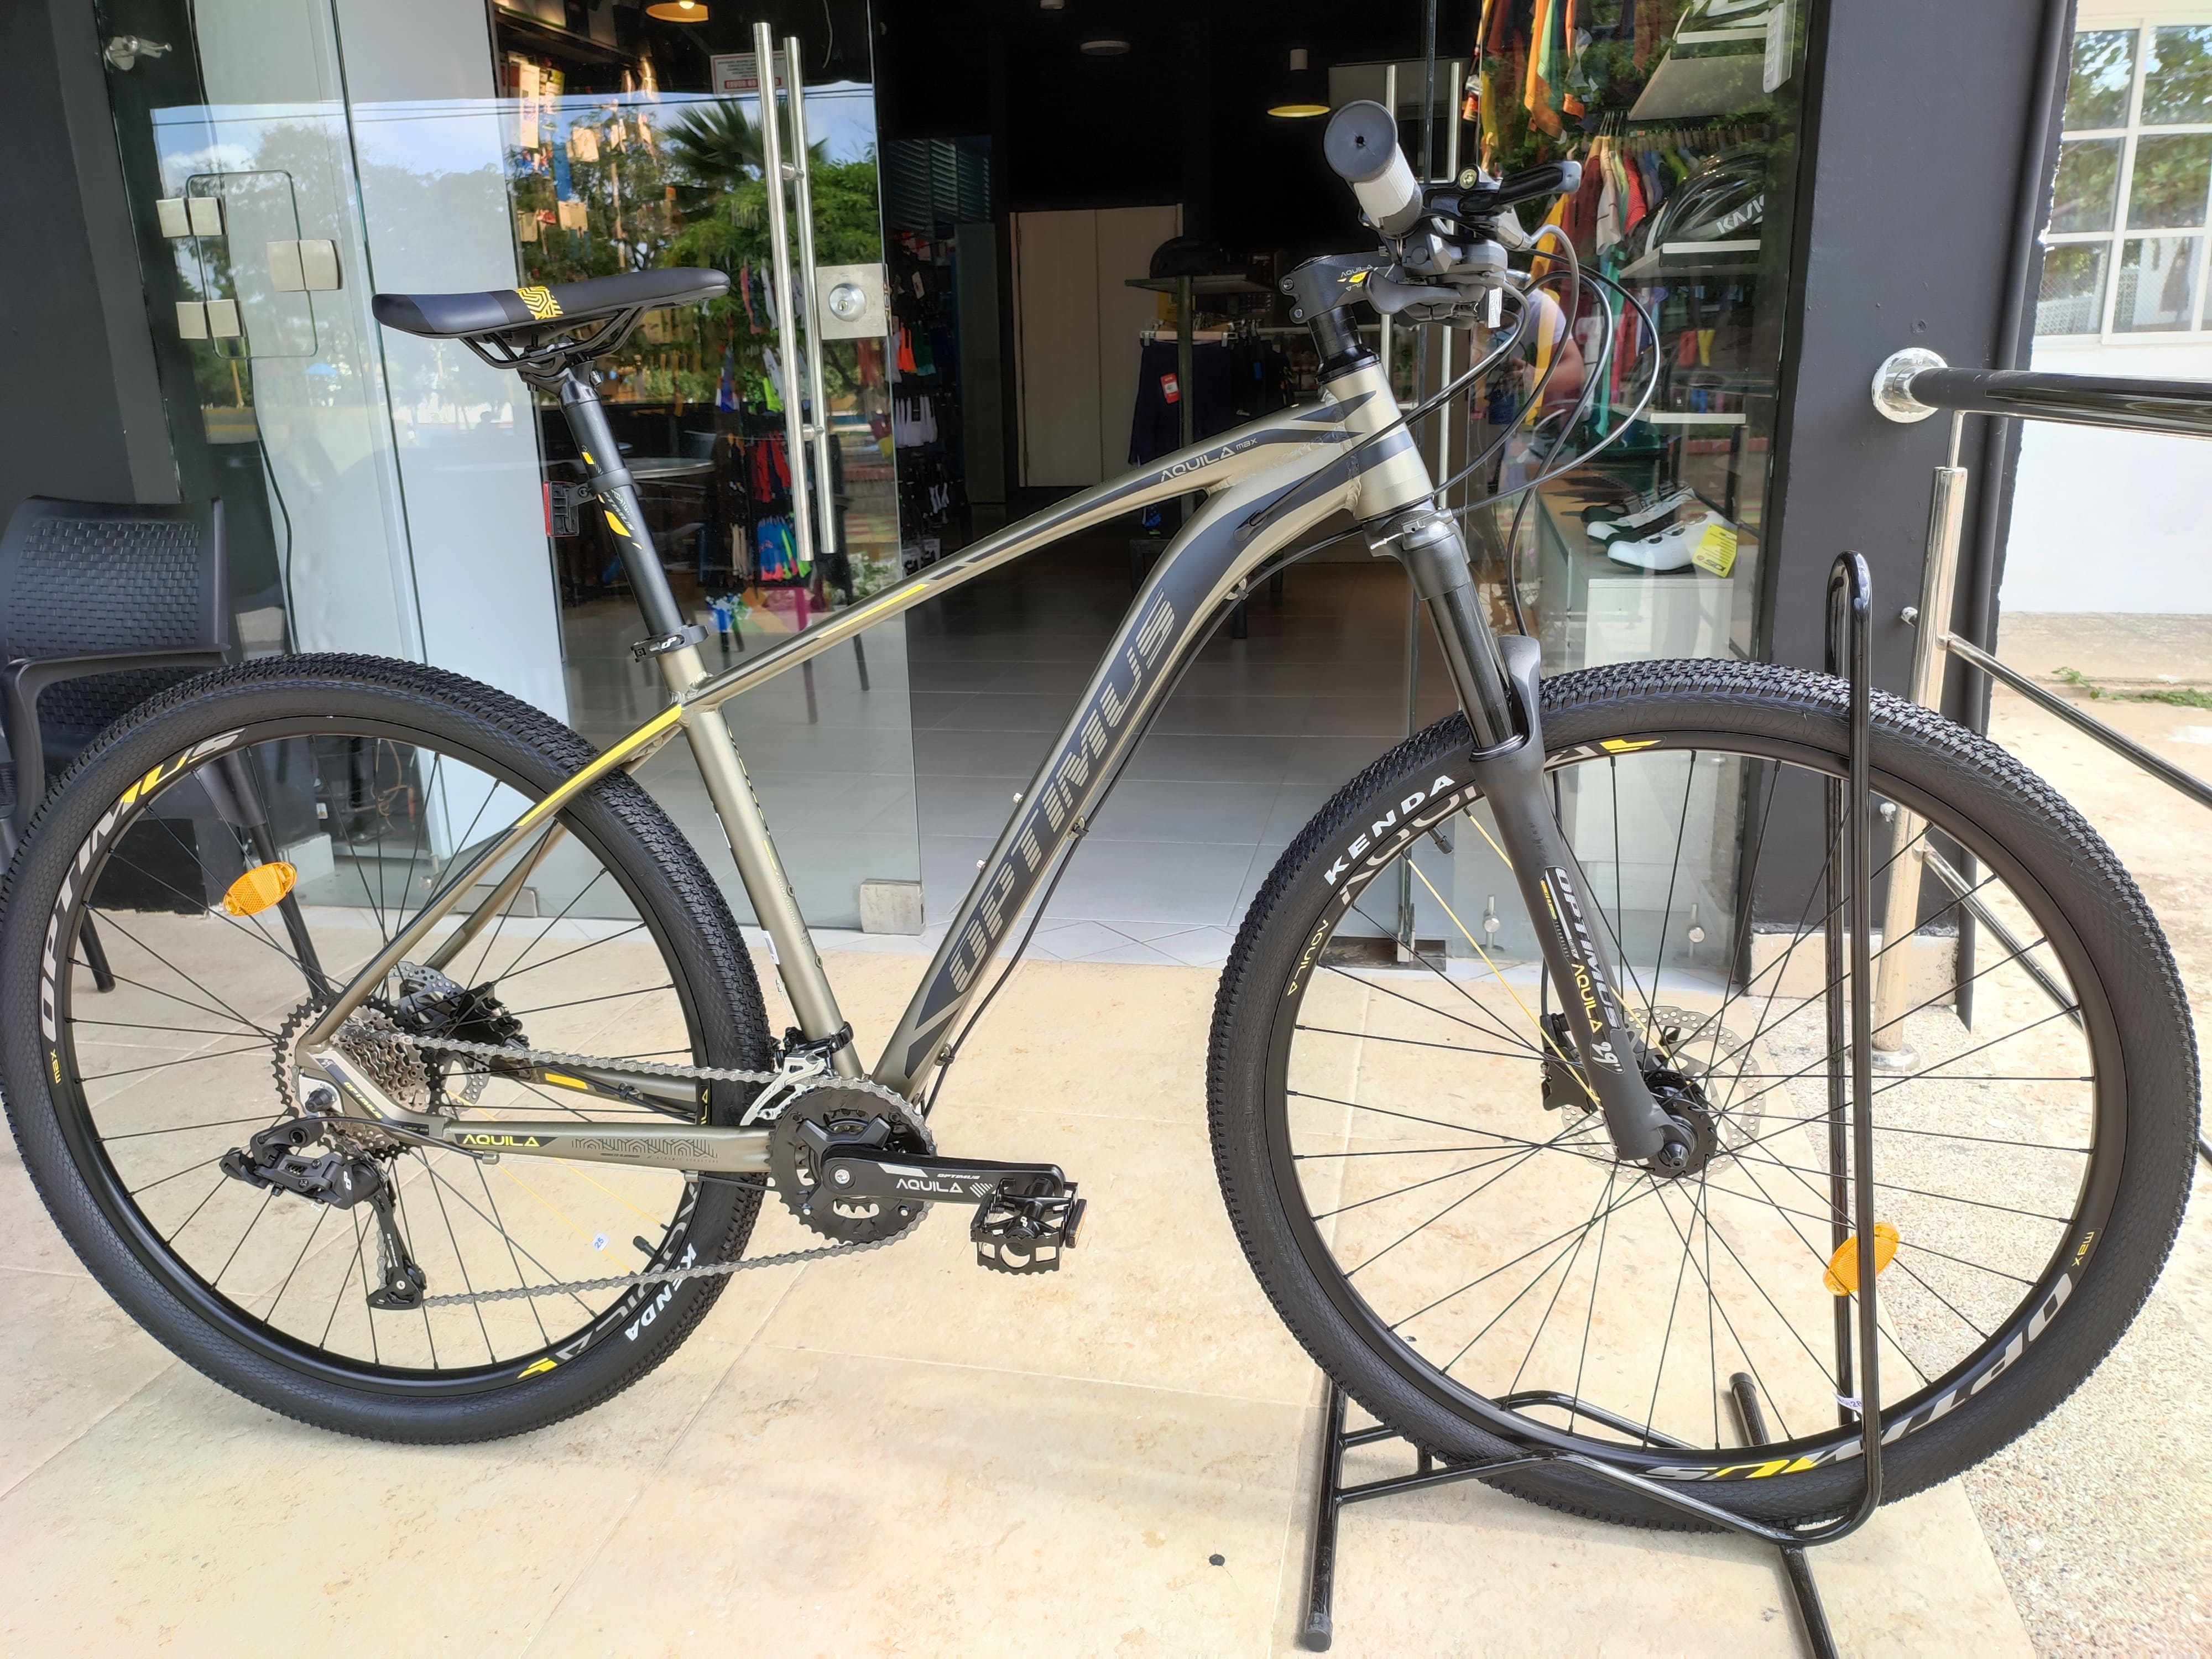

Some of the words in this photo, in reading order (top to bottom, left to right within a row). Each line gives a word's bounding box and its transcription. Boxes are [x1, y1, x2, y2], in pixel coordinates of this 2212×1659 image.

[1340, 264, 1373, 278] AQUILA
[1161, 446, 1235, 482] AQUILA
[1236, 437, 1258, 451] max
[603, 491, 635, 531] PTIMUS
[948, 587, 1175, 993] OPTIMUS
[1324, 775, 1455, 886] KENDA
[40, 728, 246, 1042] OPTIMUS
[1287, 919, 1328, 997] AQUILA
[1554, 867, 1621, 1029] OPTIMUS
[1571, 963, 1603, 1034] AQUILA
[343, 1081, 384, 1119] OPTIMUS
[463, 1134, 540, 1147] AQUILA
[896, 1178, 964, 1193] AQUILA
[1636, 1272, 2073, 1481] OPTIMUS
